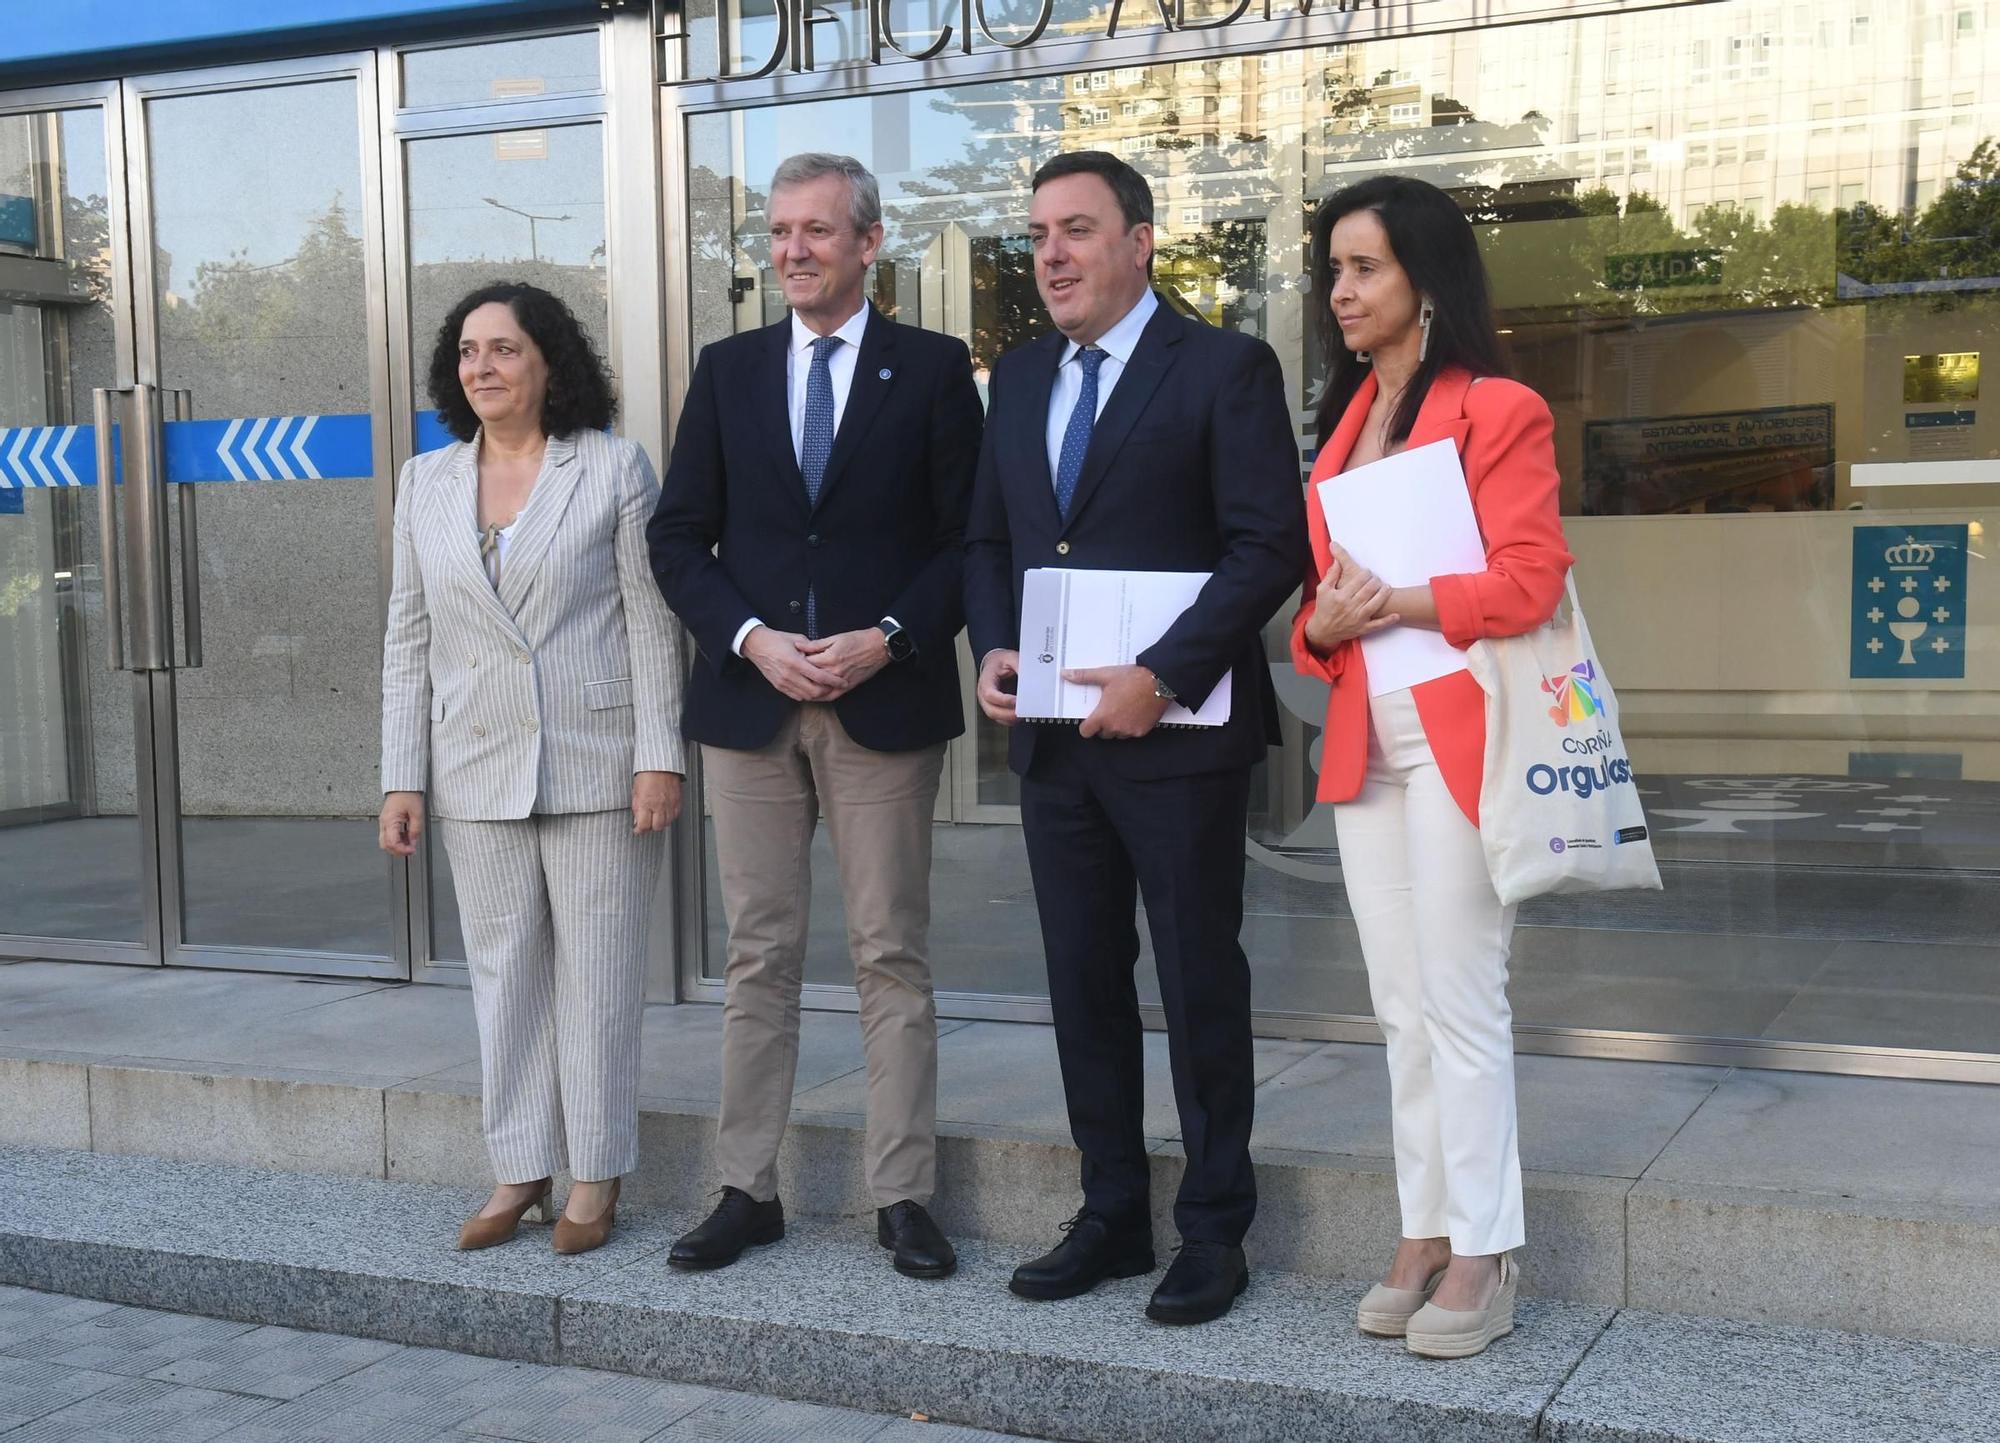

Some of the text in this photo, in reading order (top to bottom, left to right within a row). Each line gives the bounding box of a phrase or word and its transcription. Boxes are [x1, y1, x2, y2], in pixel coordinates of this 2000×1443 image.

[1641, 415, 1826, 438] ESTACIÓN DE AUTOBUSES
